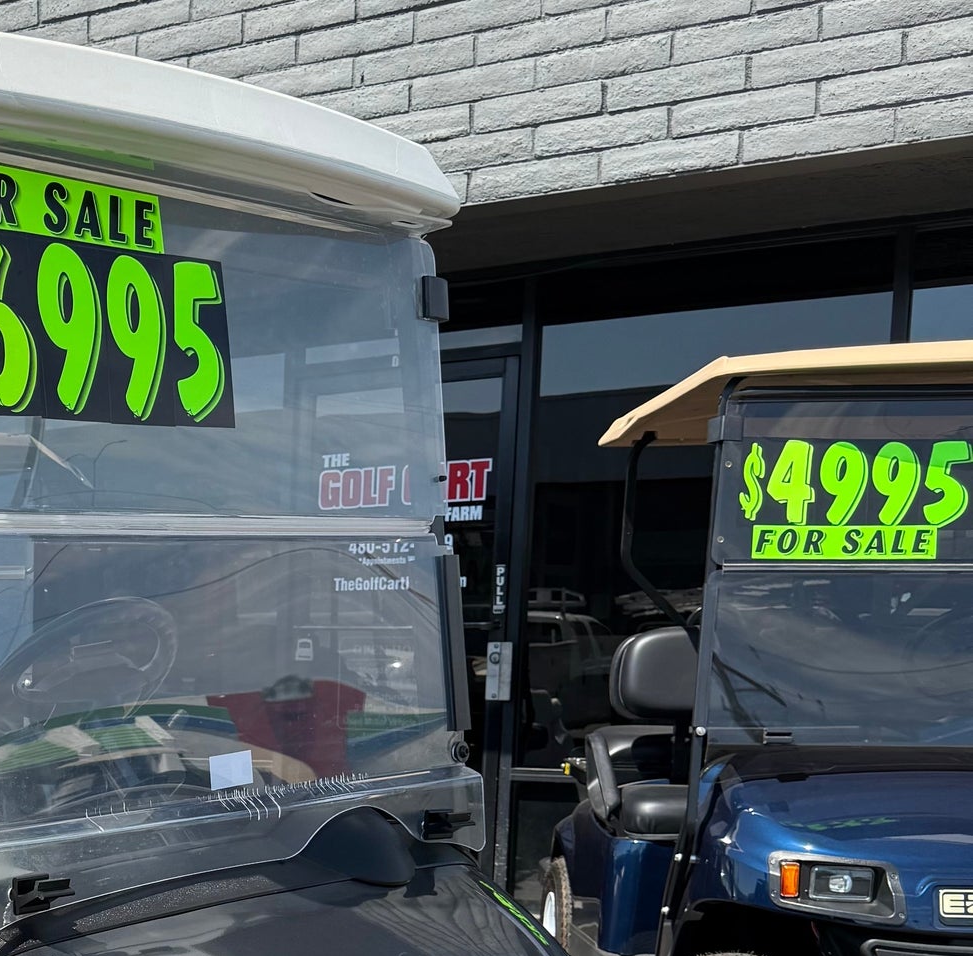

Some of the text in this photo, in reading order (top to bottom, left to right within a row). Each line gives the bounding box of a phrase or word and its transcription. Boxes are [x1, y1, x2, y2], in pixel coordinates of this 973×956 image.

[43, 181, 154, 249] SALE
[321, 453, 350, 468] THE
[318, 465, 396, 511] GOLF
[738, 439, 973, 528] $4995
[755, 528, 932, 556] FOR SALE
[495, 566, 505, 605] PULL
